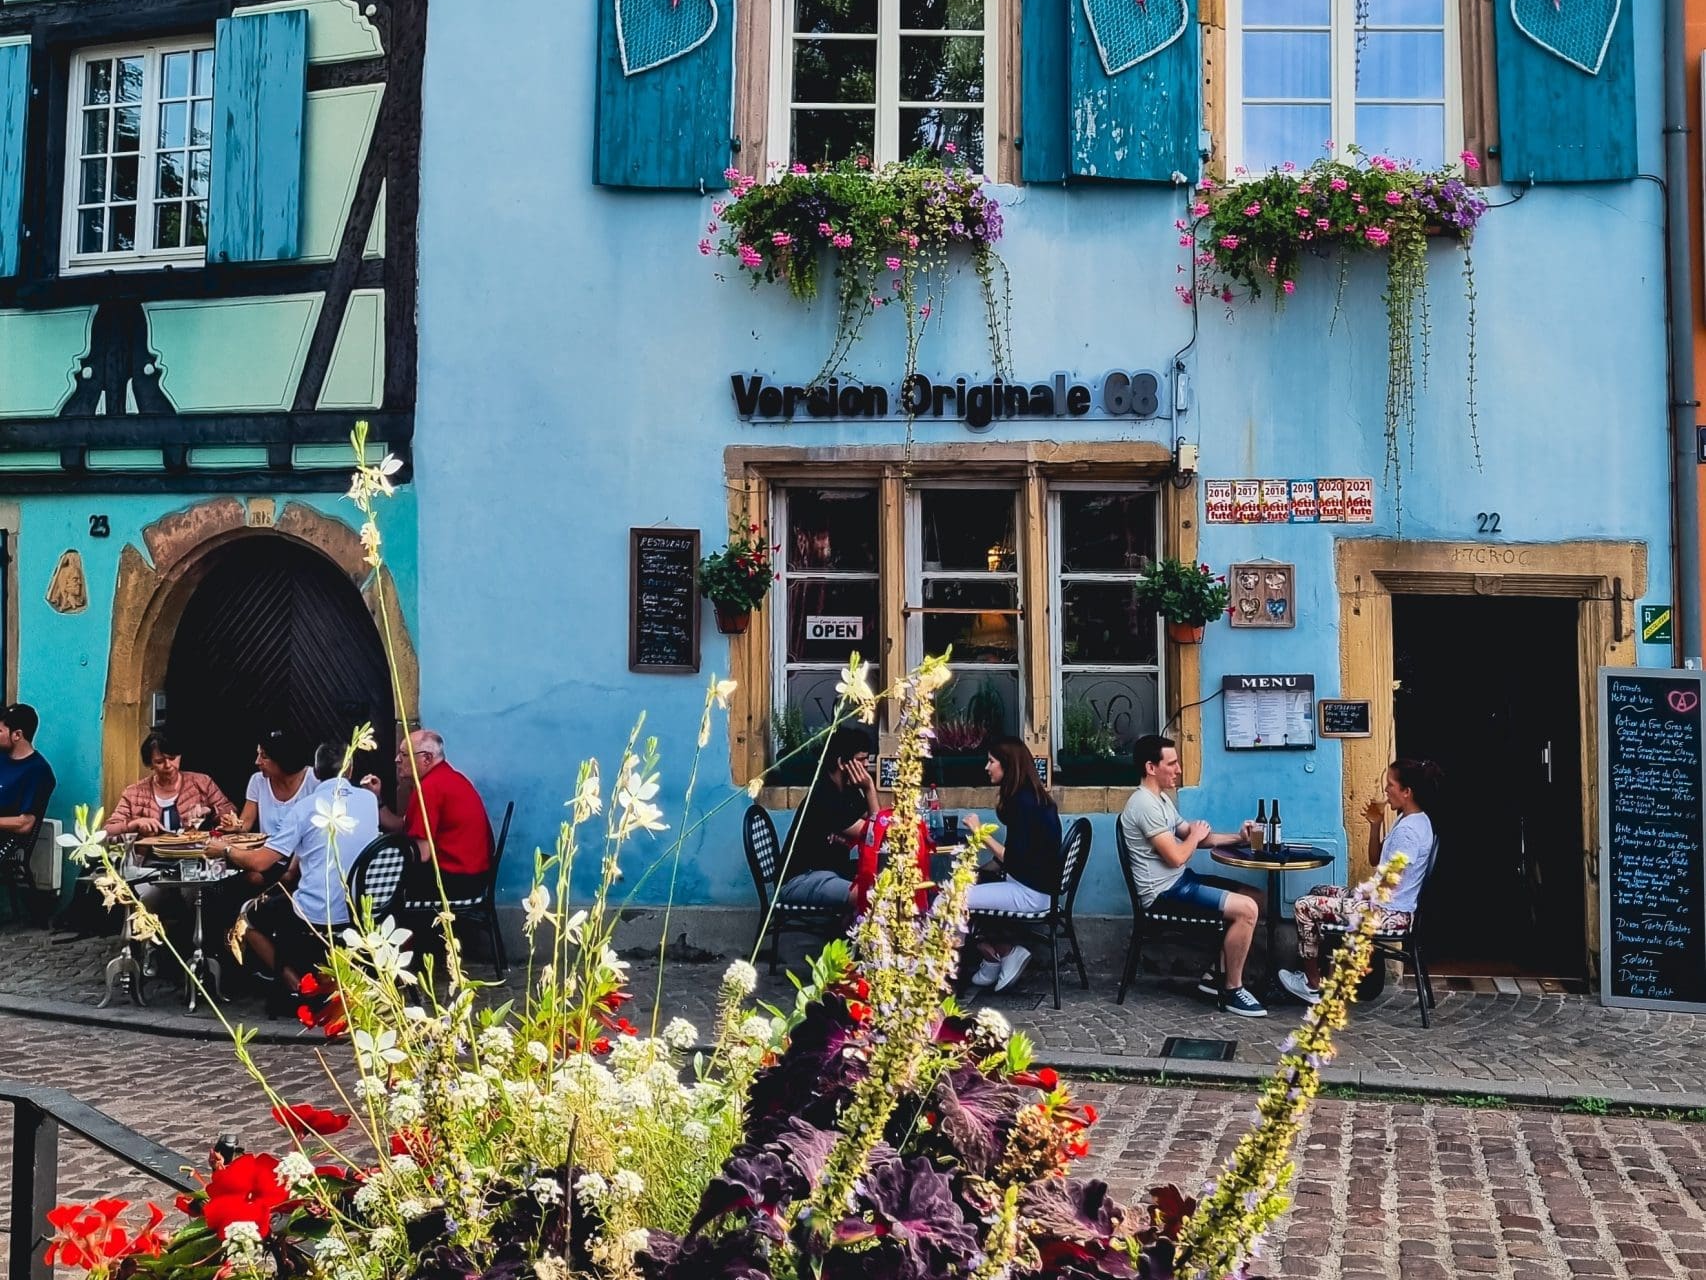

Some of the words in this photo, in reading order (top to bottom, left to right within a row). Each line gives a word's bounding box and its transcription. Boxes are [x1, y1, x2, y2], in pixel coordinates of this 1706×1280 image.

[730, 373, 888, 416] Version
[902, 373, 1091, 428] Originale
[1103, 372, 1159, 415] 68
[1292, 484, 1313, 493] 2019
[1319, 481, 1343, 491] 2020
[1346, 481, 1370, 491] 2021
[1208, 489, 1230, 497] 2016
[89, 514, 110, 538] 23
[1477, 512, 1502, 533] 22
[640, 537, 691, 549] RESTAURANT
[812, 624, 857, 637] OPEN
[1241, 677, 1297, 688] MENU
